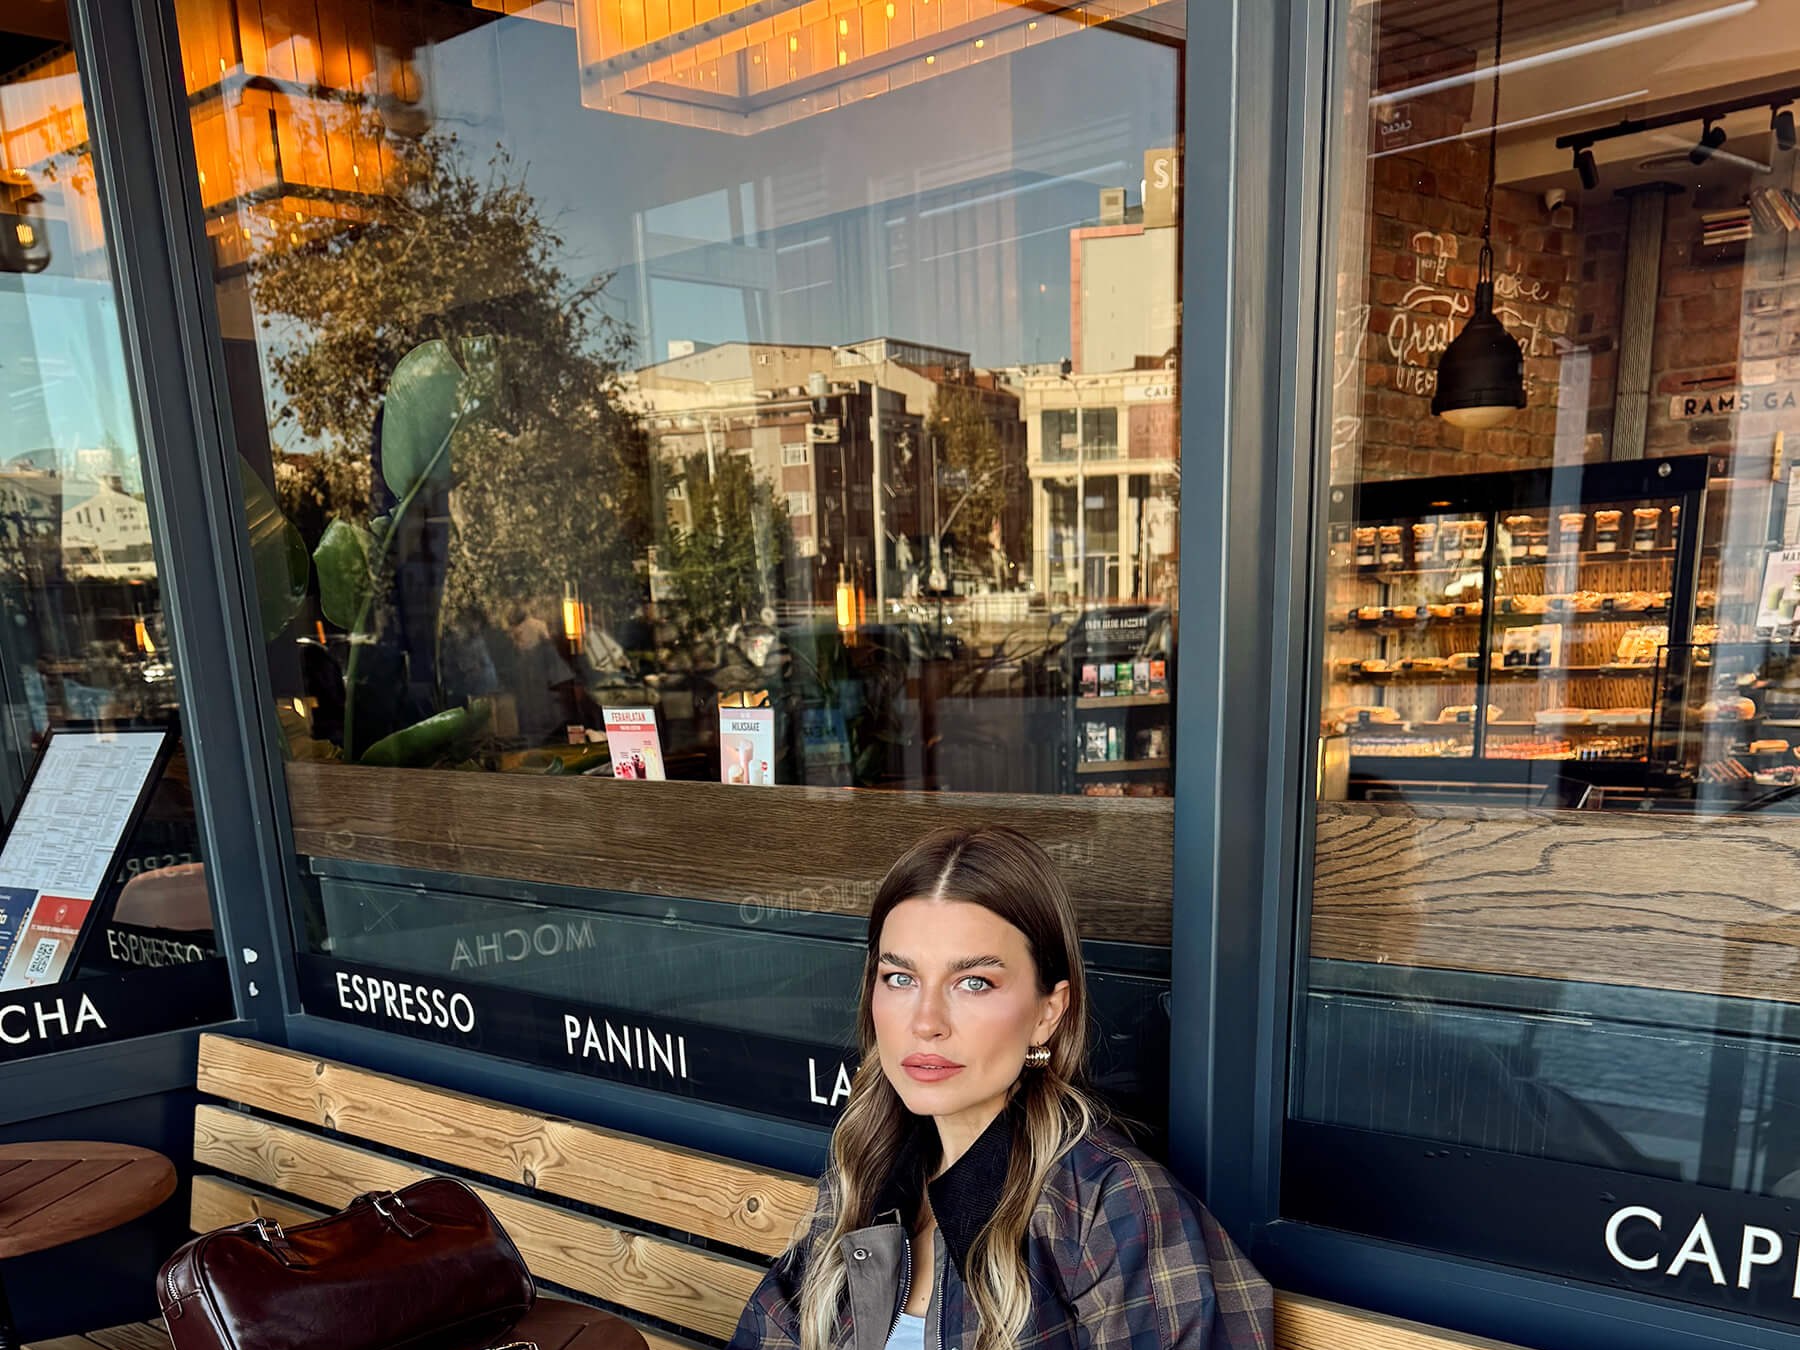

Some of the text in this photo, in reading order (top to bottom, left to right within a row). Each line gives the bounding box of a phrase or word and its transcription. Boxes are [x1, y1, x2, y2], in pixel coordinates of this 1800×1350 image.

[1684, 394, 1750, 416] RAMS
[336, 971, 476, 1033] ESPRESSO
[564, 1013, 687, 1079] PANINI
[808, 1057, 860, 1107] LA
